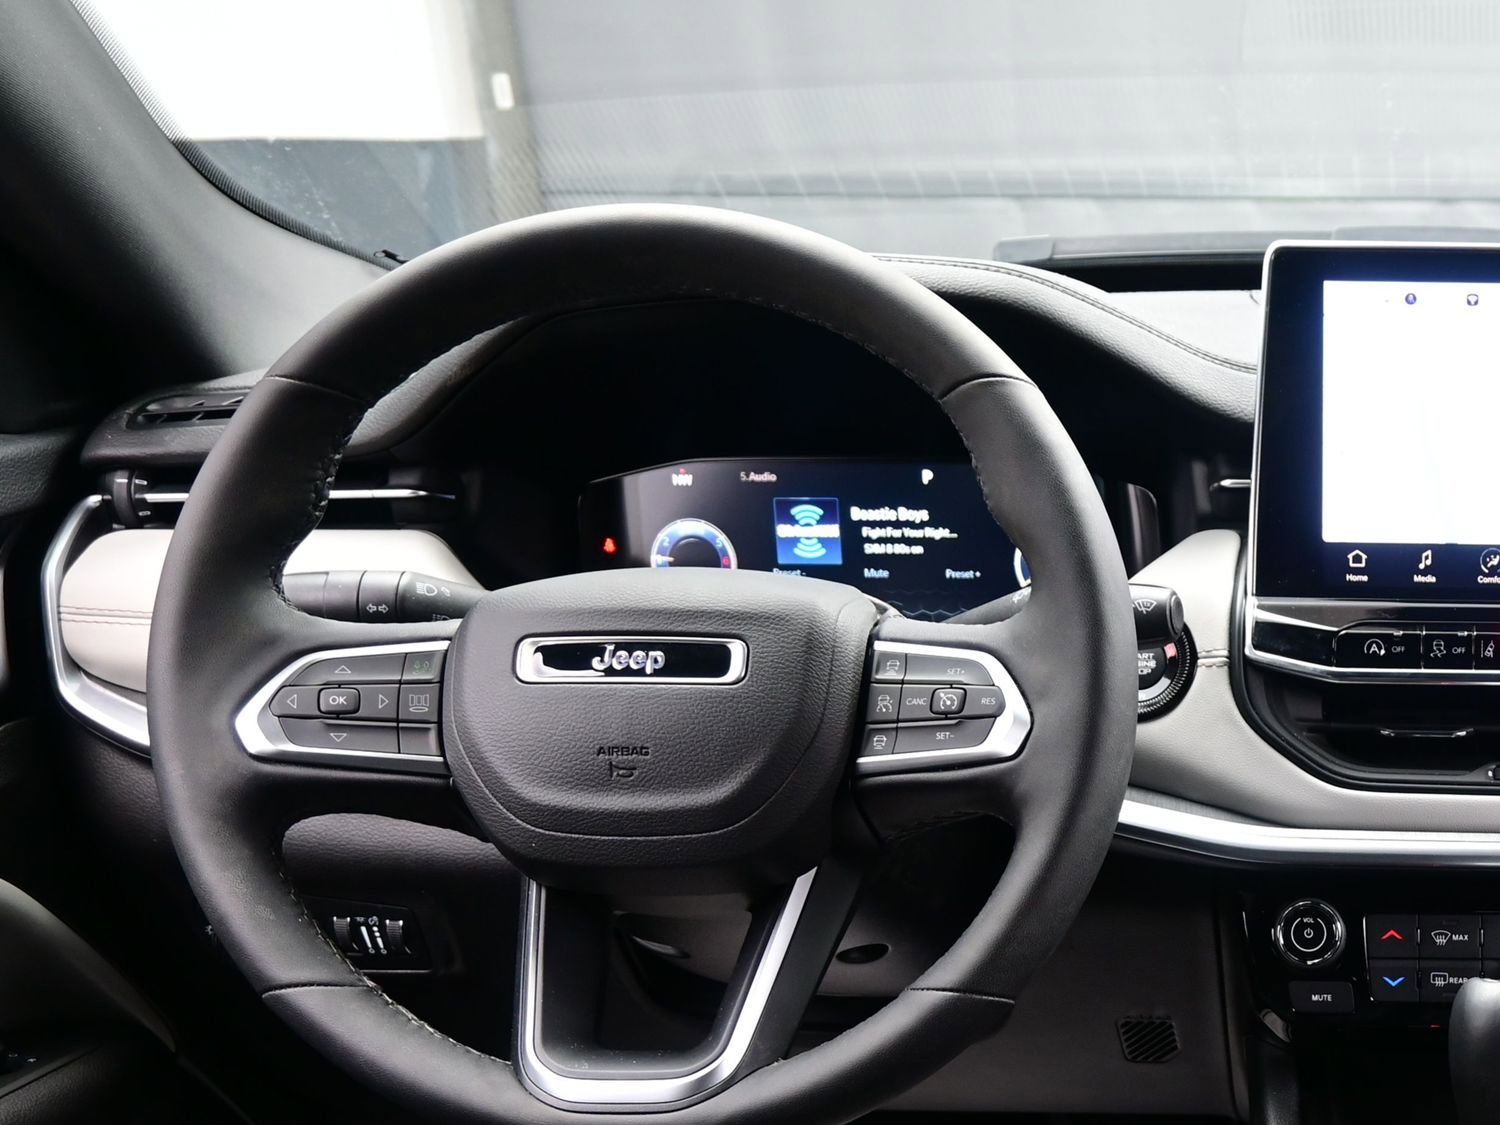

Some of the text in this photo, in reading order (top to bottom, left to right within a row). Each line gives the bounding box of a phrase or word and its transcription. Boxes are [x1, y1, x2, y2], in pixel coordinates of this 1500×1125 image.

[921, 468, 934, 485] P
[849, 506, 930, 524] Beastie Boys
[864, 567, 889, 578] Mute
[945, 568, 974, 579] Preset
[1346, 573, 1369, 583] Home
[1413, 574, 1436, 584] Media
[1391, 646, 1405, 654] OFF
[1451, 647, 1466, 655] OFF
[591, 643, 666, 675] Jeep
[329, 695, 348, 705] OK
[905, 697, 928, 706] CANC
[981, 697, 996, 706] RES
[596, 745, 650, 758] AIRBAG
[1452, 934, 1469, 942] MAX
[1311, 994, 1332, 1002] MUTE
